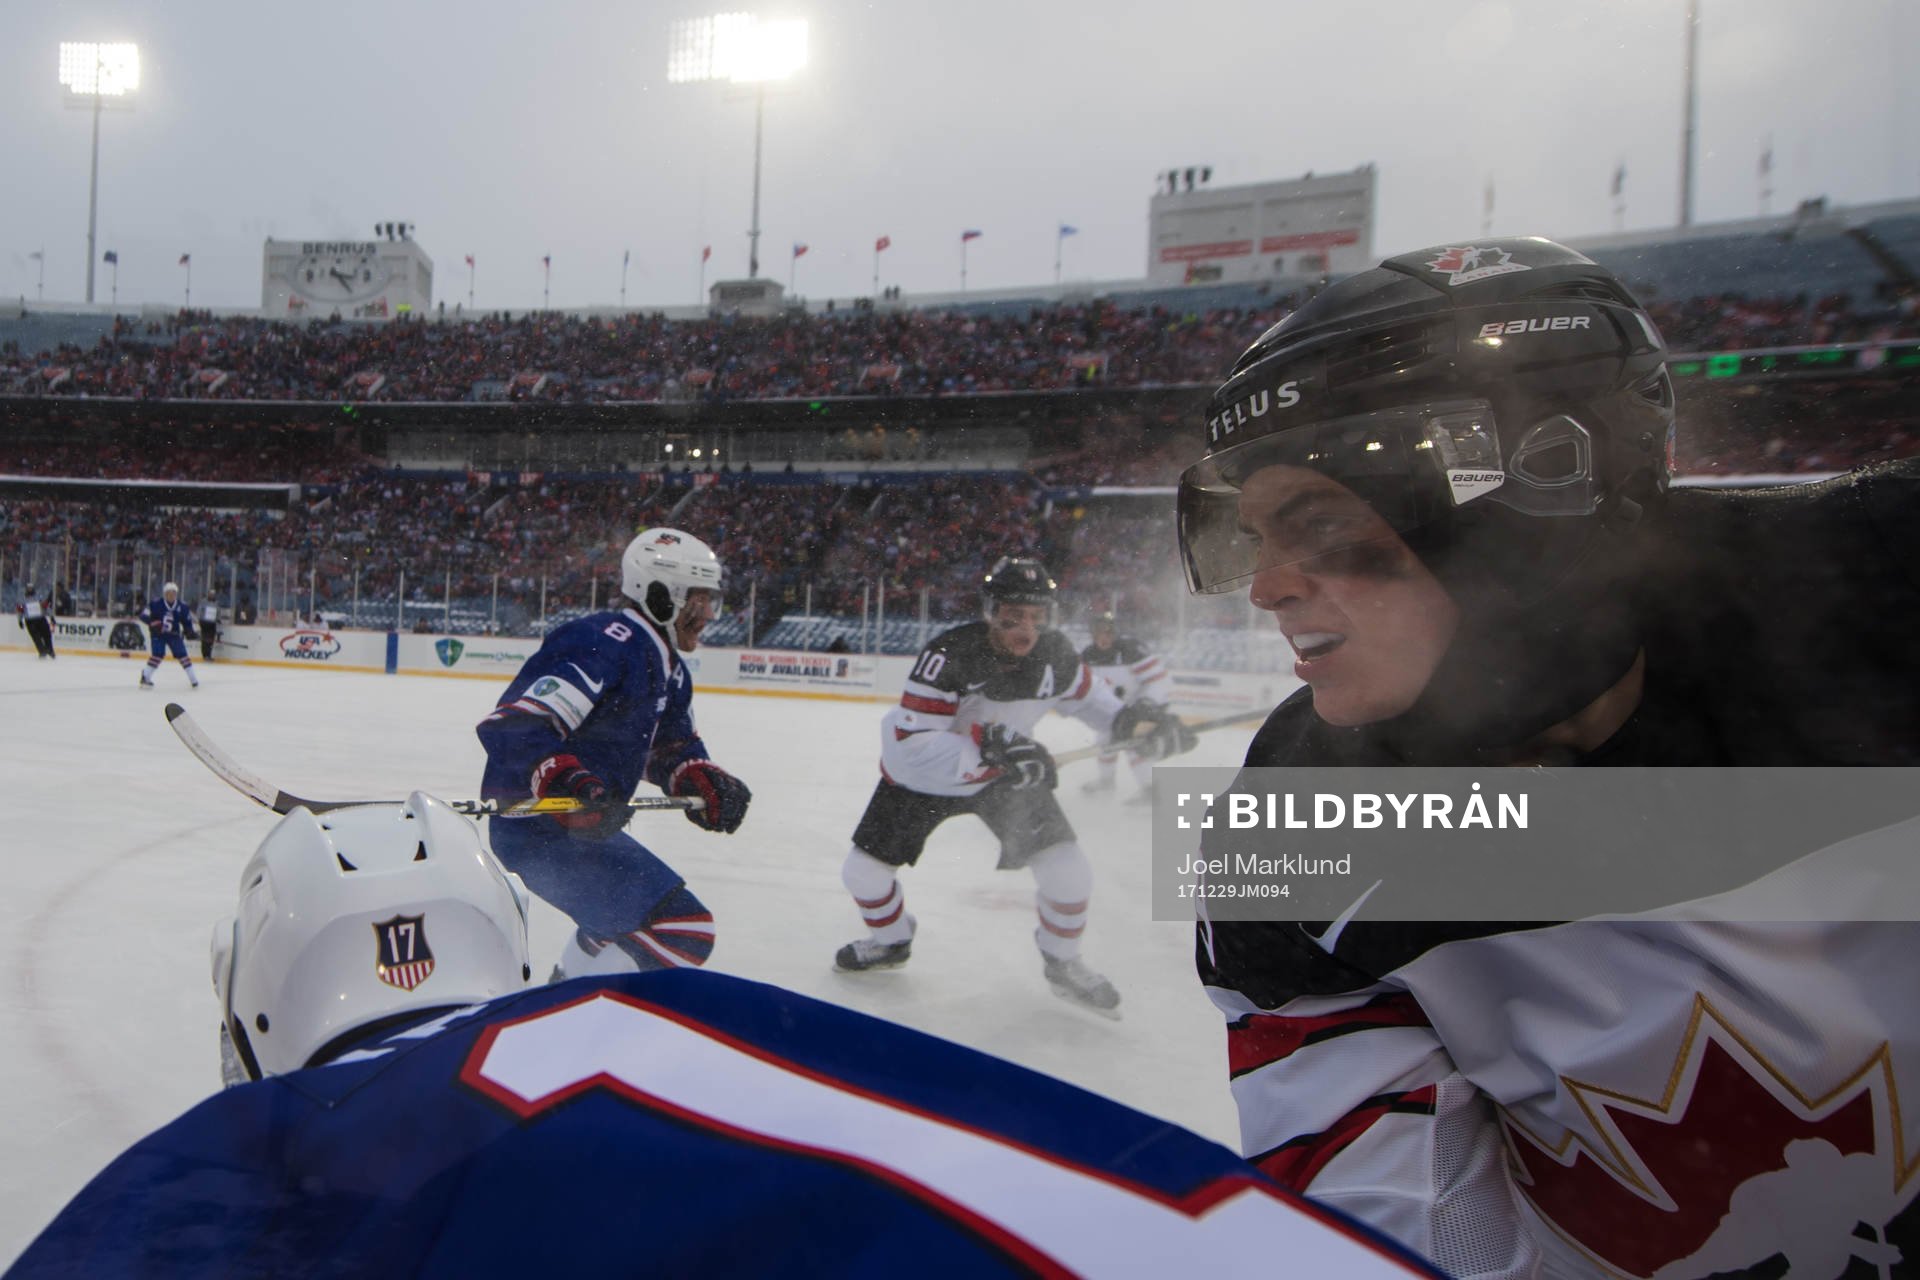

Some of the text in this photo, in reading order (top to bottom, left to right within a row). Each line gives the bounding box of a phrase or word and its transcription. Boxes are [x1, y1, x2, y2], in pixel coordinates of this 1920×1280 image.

[302, 242, 377, 255] BENRUS
[1210, 381, 1300, 442] TELUS
[56, 623, 105, 636] TISSOT
[163, 615, 174, 633] 5
[604, 622, 633, 642] 8
[284, 648, 332, 660] HOCKEY
[739, 663, 831, 678] NOW AVAILABLE
[914, 650, 946, 682] 10
[1036, 664, 1054, 699] A
[388, 922, 416, 963] 17
